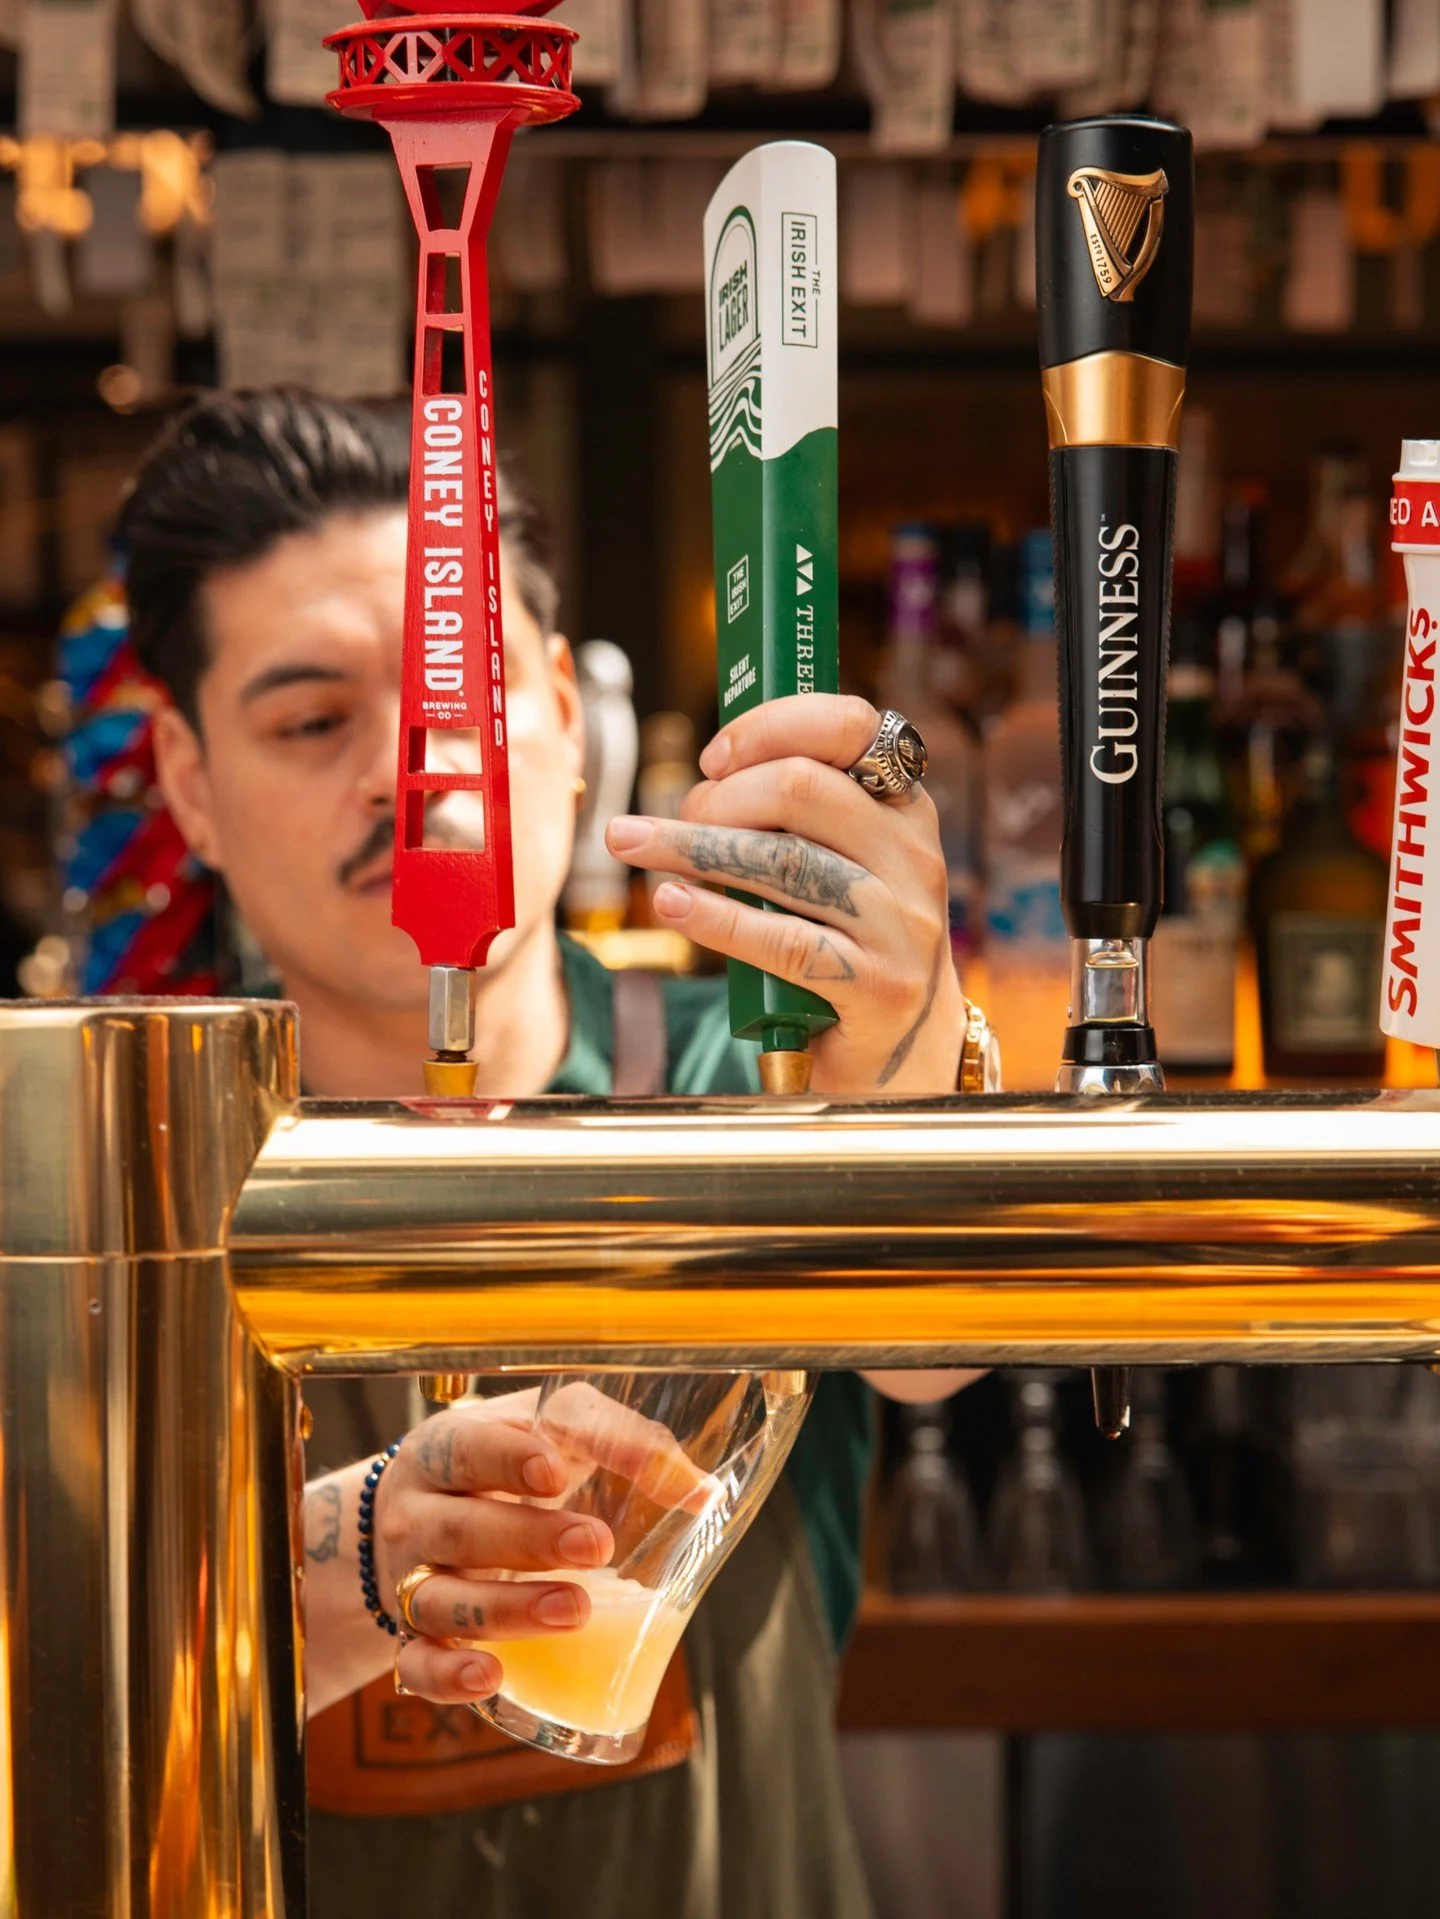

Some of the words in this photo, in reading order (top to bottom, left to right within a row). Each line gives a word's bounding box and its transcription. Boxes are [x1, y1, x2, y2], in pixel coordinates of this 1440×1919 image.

[790, 220, 807, 279] IRISH
[1096, 256, 1112, 284] 1759
[719, 259, 747, 307] IRISH
[811, 270, 821, 296] THE
[719, 284, 748, 352] LAGER
[790, 286, 807, 339] EXIT
[424, 399, 463, 527] CONEY
[479, 370, 493, 532] CONEY
[487, 551, 504, 747] ISLAND
[729, 653, 750, 685] SILENT
[1089, 523, 1140, 784] GUINNESS
[422, 701, 467, 711] BREWING
[724, 666, 757, 708] DEPARTURE
[437, 711, 452, 720] CO
